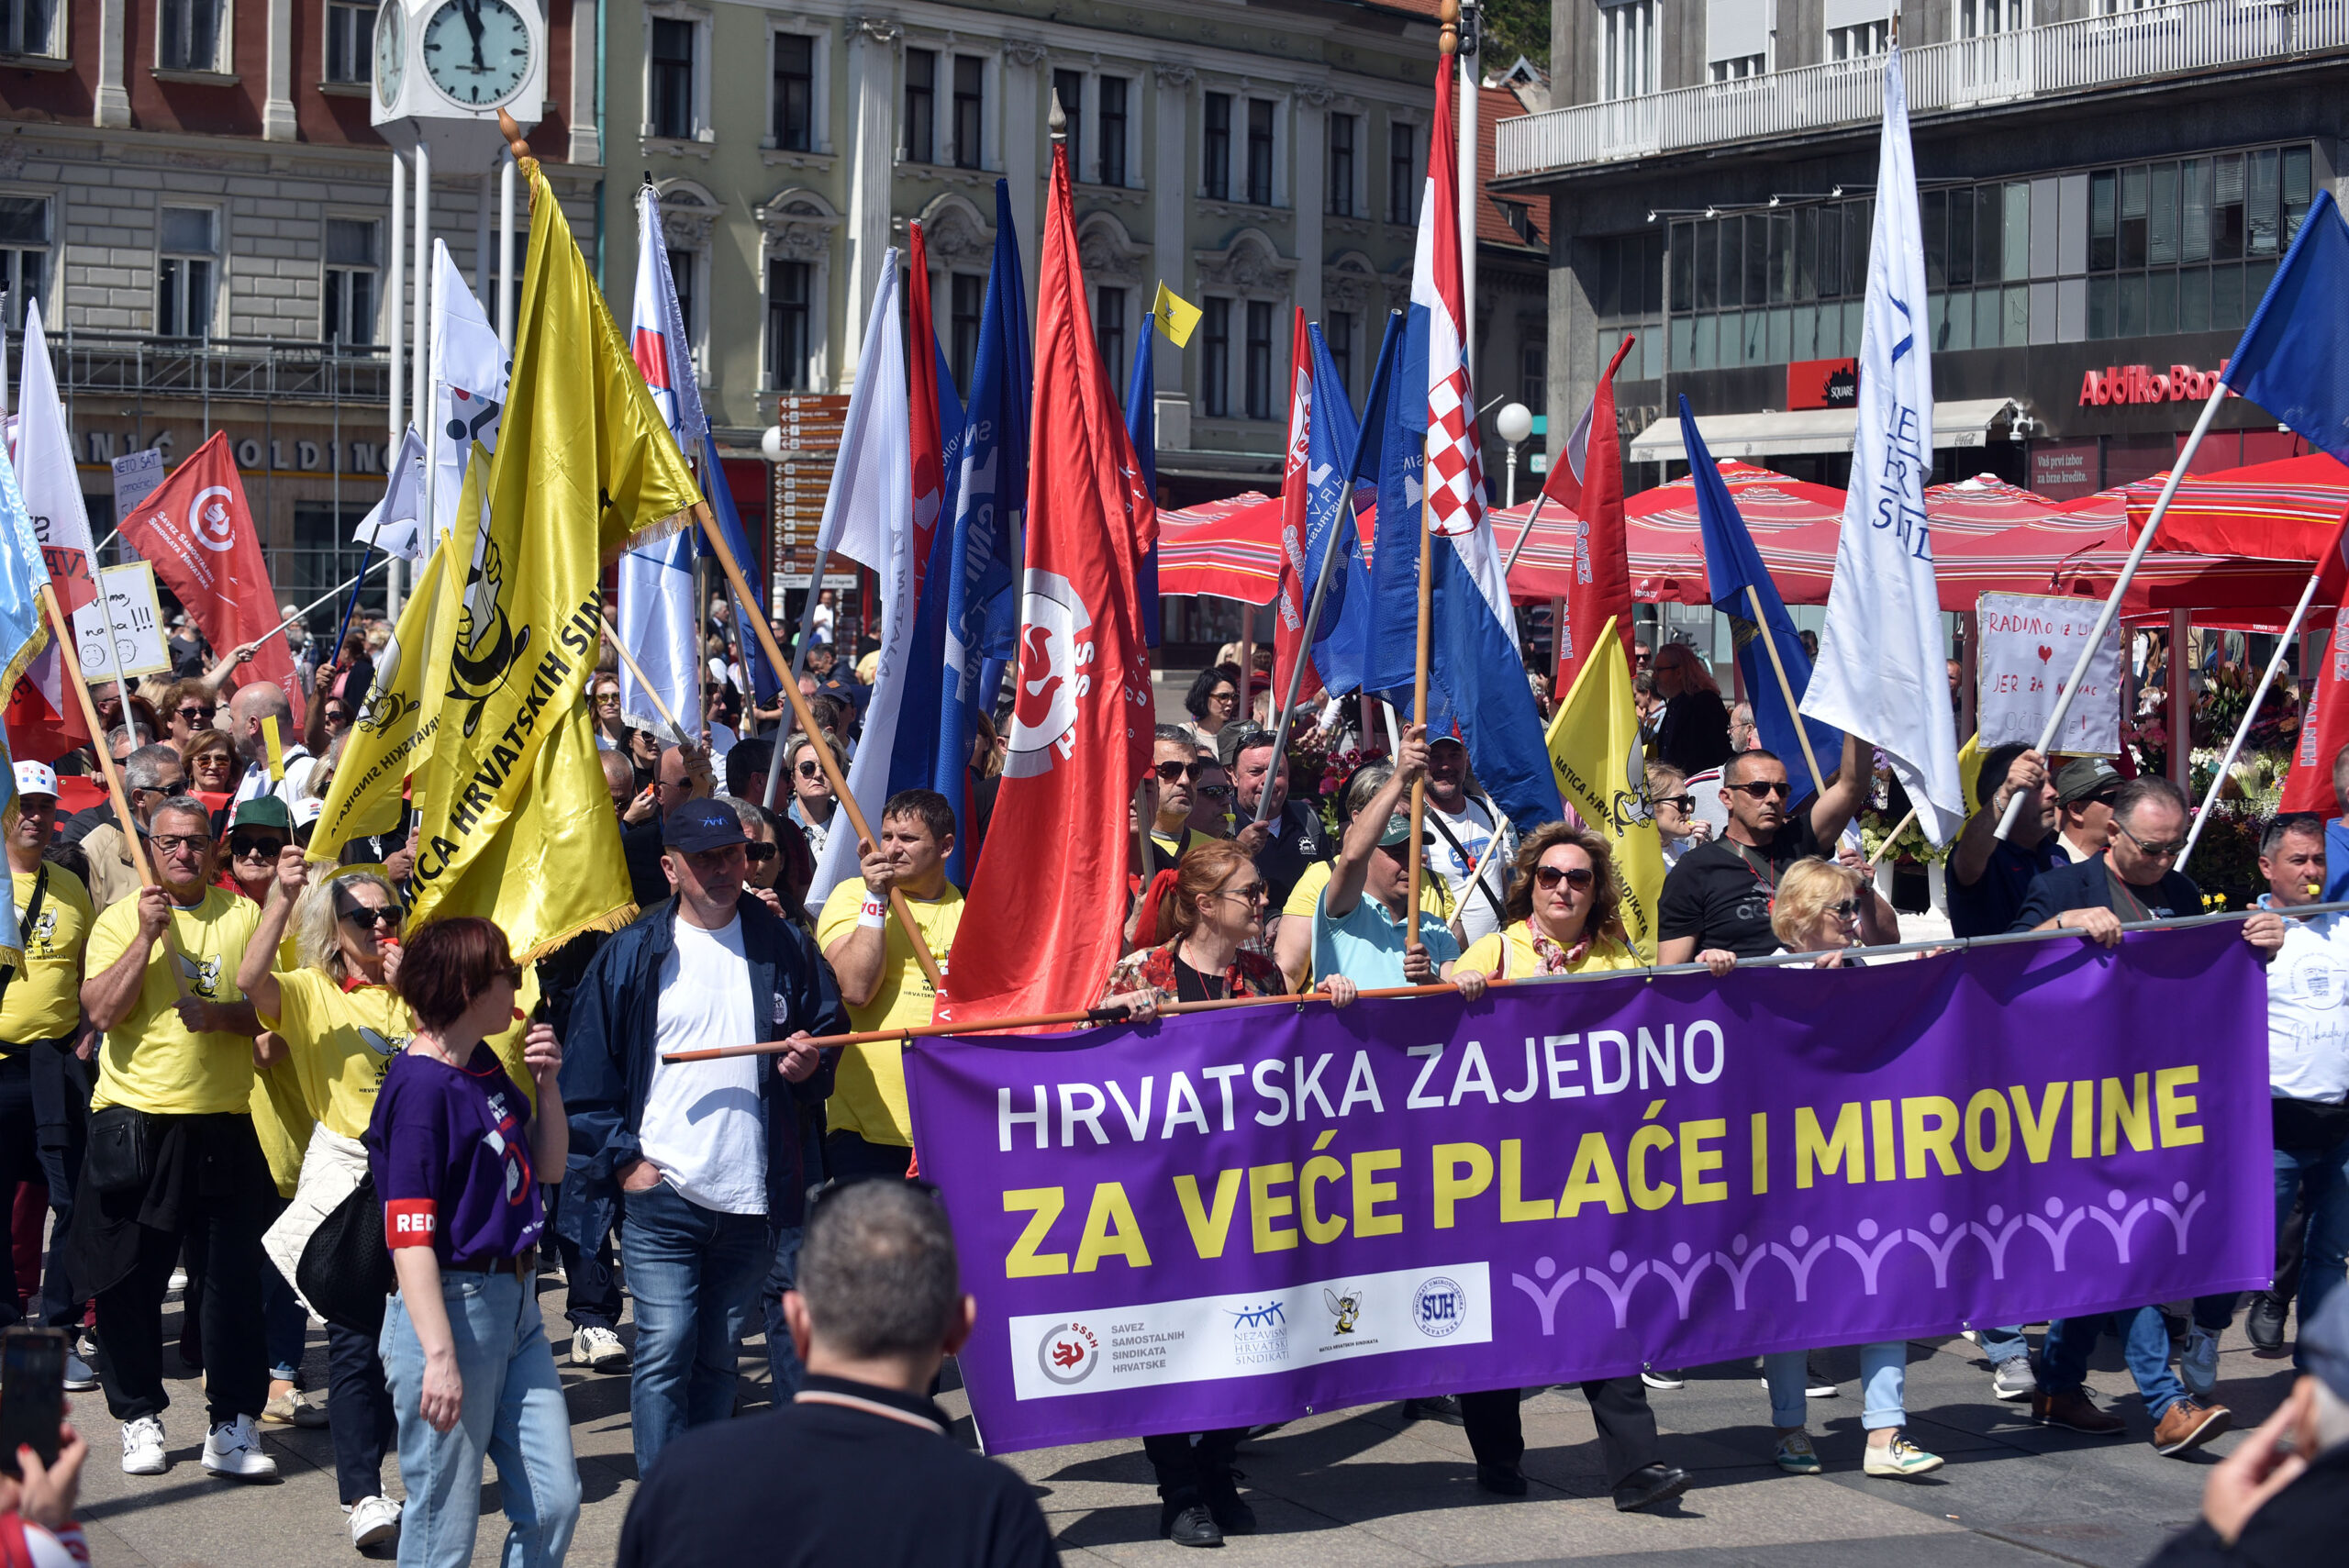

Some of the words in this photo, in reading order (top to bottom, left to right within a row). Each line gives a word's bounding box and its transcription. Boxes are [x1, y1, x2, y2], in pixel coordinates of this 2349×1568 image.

[1831, 384, 1854, 400] SQUARE
[2078, 364, 2171, 406] Addiko
[115, 458, 137, 473] NETO
[141, 453, 157, 469] SAT
[229, 438, 390, 473] OLDIN
[2037, 456, 2050, 467] Vaš
[2050, 456, 2065, 470] prvi
[2065, 455, 2083, 466] izbor
[2037, 475, 2045, 484] za
[2045, 472, 2061, 484] brze
[2061, 472, 2087, 484] kredite.
[157, 510, 180, 536] SAVEZ
[148, 517, 182, 554] SINDIKATA
[180, 550, 210, 591] HRVATSKE
[1576, 520, 1594, 585] SAVEZ
[1989, 612, 2054, 635] RADIMO
[1992, 673, 2019, 694] JER
[2055, 683, 2098, 696] NVAC
[449, 650, 572, 837] HRVATSKIH
[1554, 754, 1586, 796] MATICA
[1585, 791, 1615, 828] HRVA
[997, 1049, 1385, 1152] HRVATSKA
[1406, 1018, 1725, 1110] ZAJEDNO
[1002, 1181, 1152, 1279] ZA
[1172, 1129, 1403, 1260] VEĆE
[1431, 1098, 1729, 1229] PLAĆE
[1751, 1111, 1768, 1195] I
[1794, 1064, 2205, 1190] MIROVINE
[396, 1213, 438, 1232] RED
[1422, 1292, 1455, 1321] SUH
[1071, 1322, 1099, 1349] SSSH
[1110, 1322, 1145, 1334] SAVEZ
[1234, 1328, 1287, 1342] NEZAVISNI
[1111, 1330, 1186, 1348] SAMOSTALNIH
[1234, 1340, 1288, 1354] HRVATSKI
[1355, 1338, 1379, 1347] SINDIKATA
[1112, 1346, 1167, 1361] SINDIKATA
[1235, 1351, 1290, 1365] SINDIKATI
[1112, 1359, 1167, 1373] HRVATSKE
